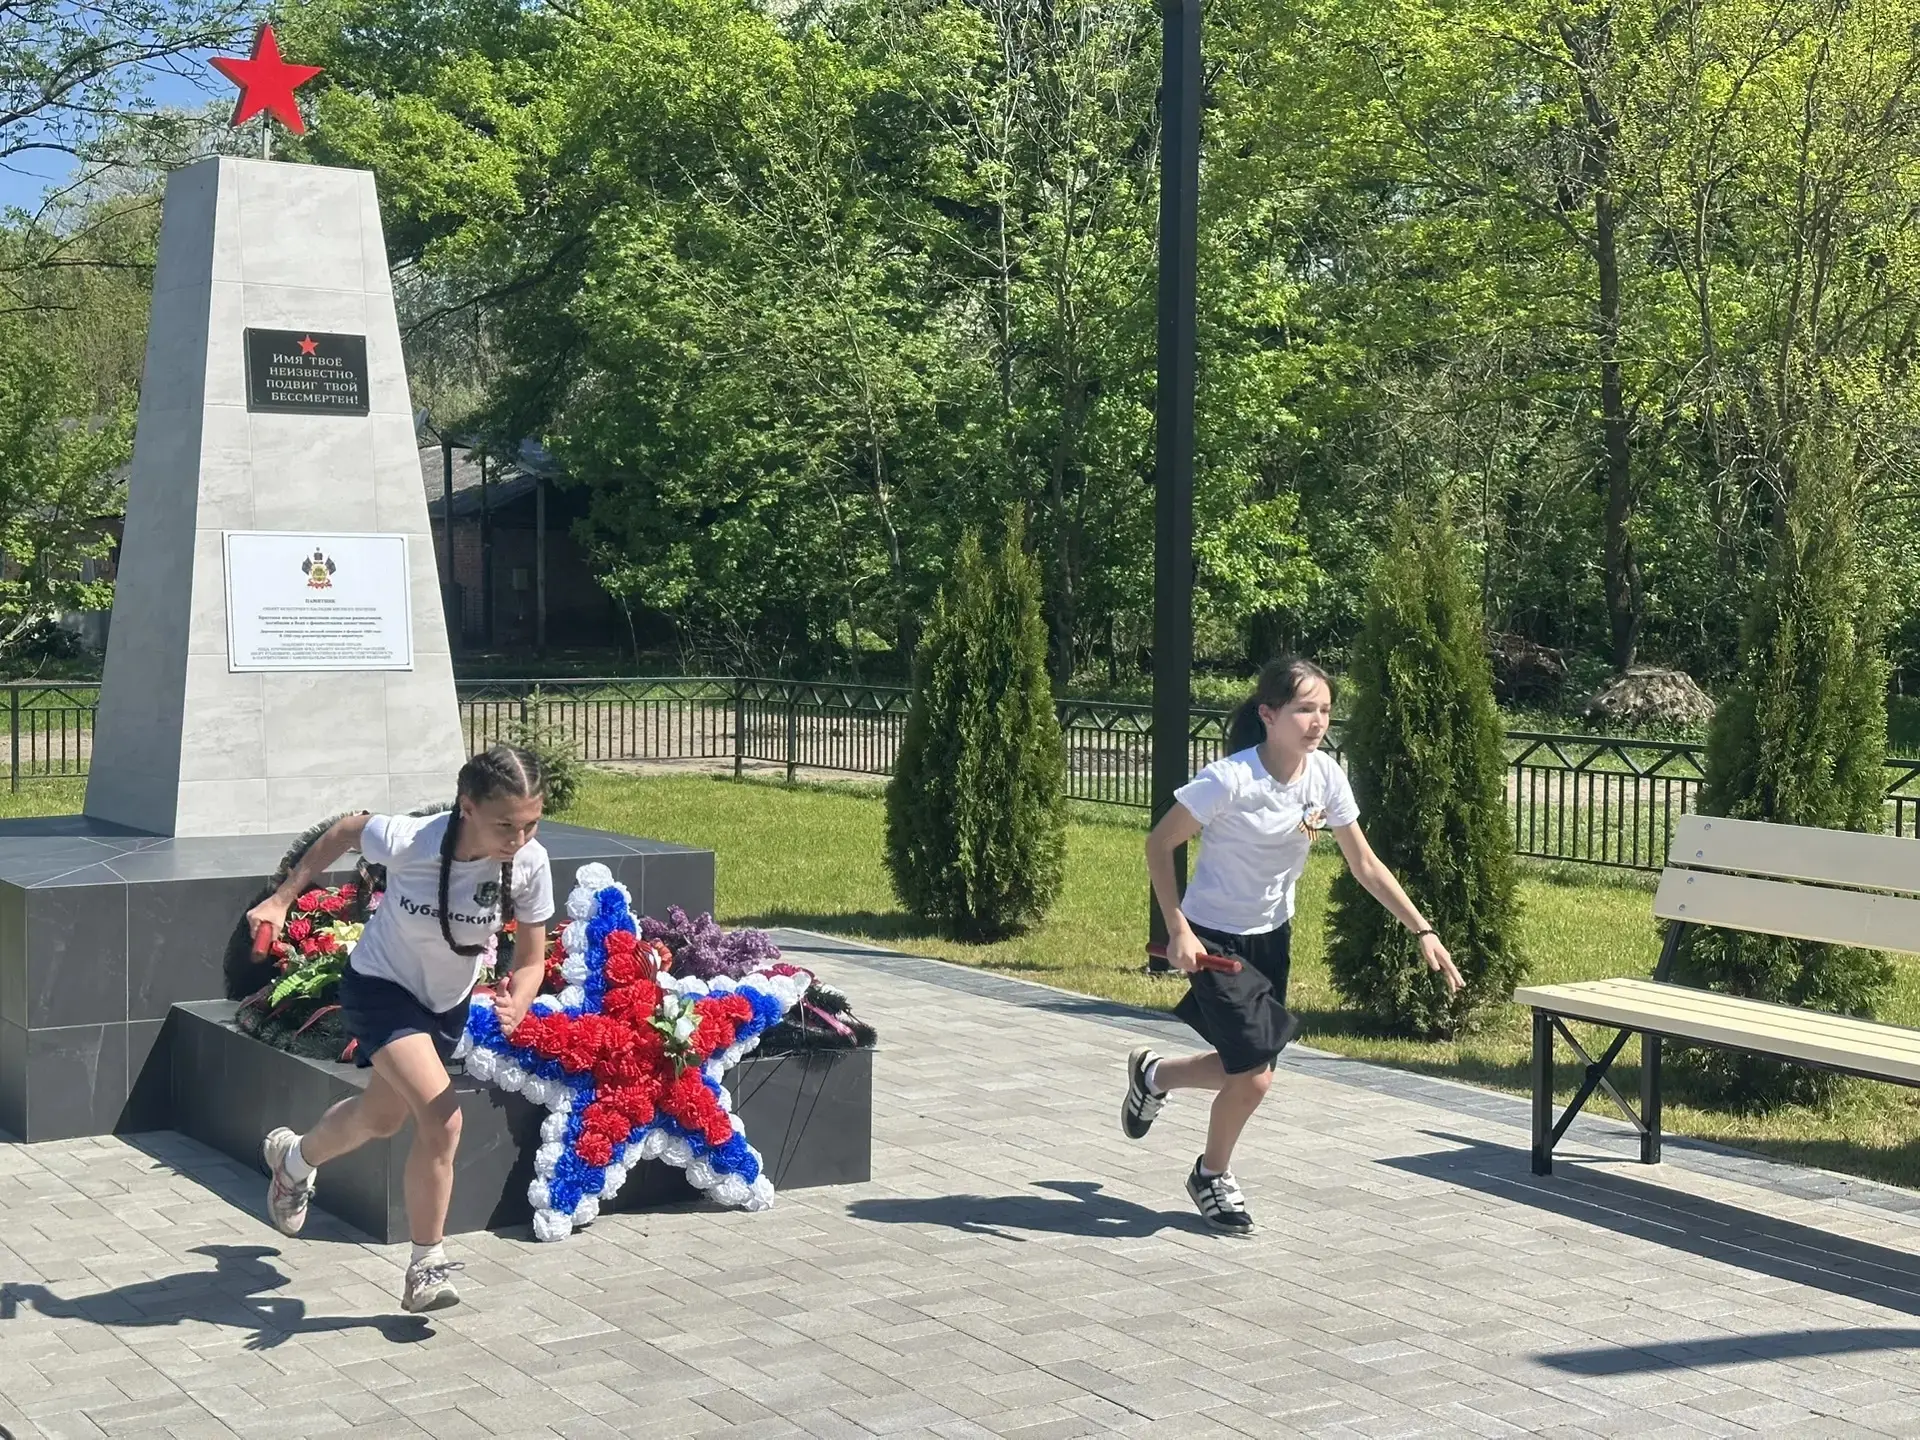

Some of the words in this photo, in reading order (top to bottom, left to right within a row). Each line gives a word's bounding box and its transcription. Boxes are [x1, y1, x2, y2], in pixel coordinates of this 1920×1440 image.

[266, 379, 318, 390] ПОДВИГ
[324, 381, 358, 392] ТВОЙ
[271, 392, 358, 404] БЕССМЕРТЕН!
